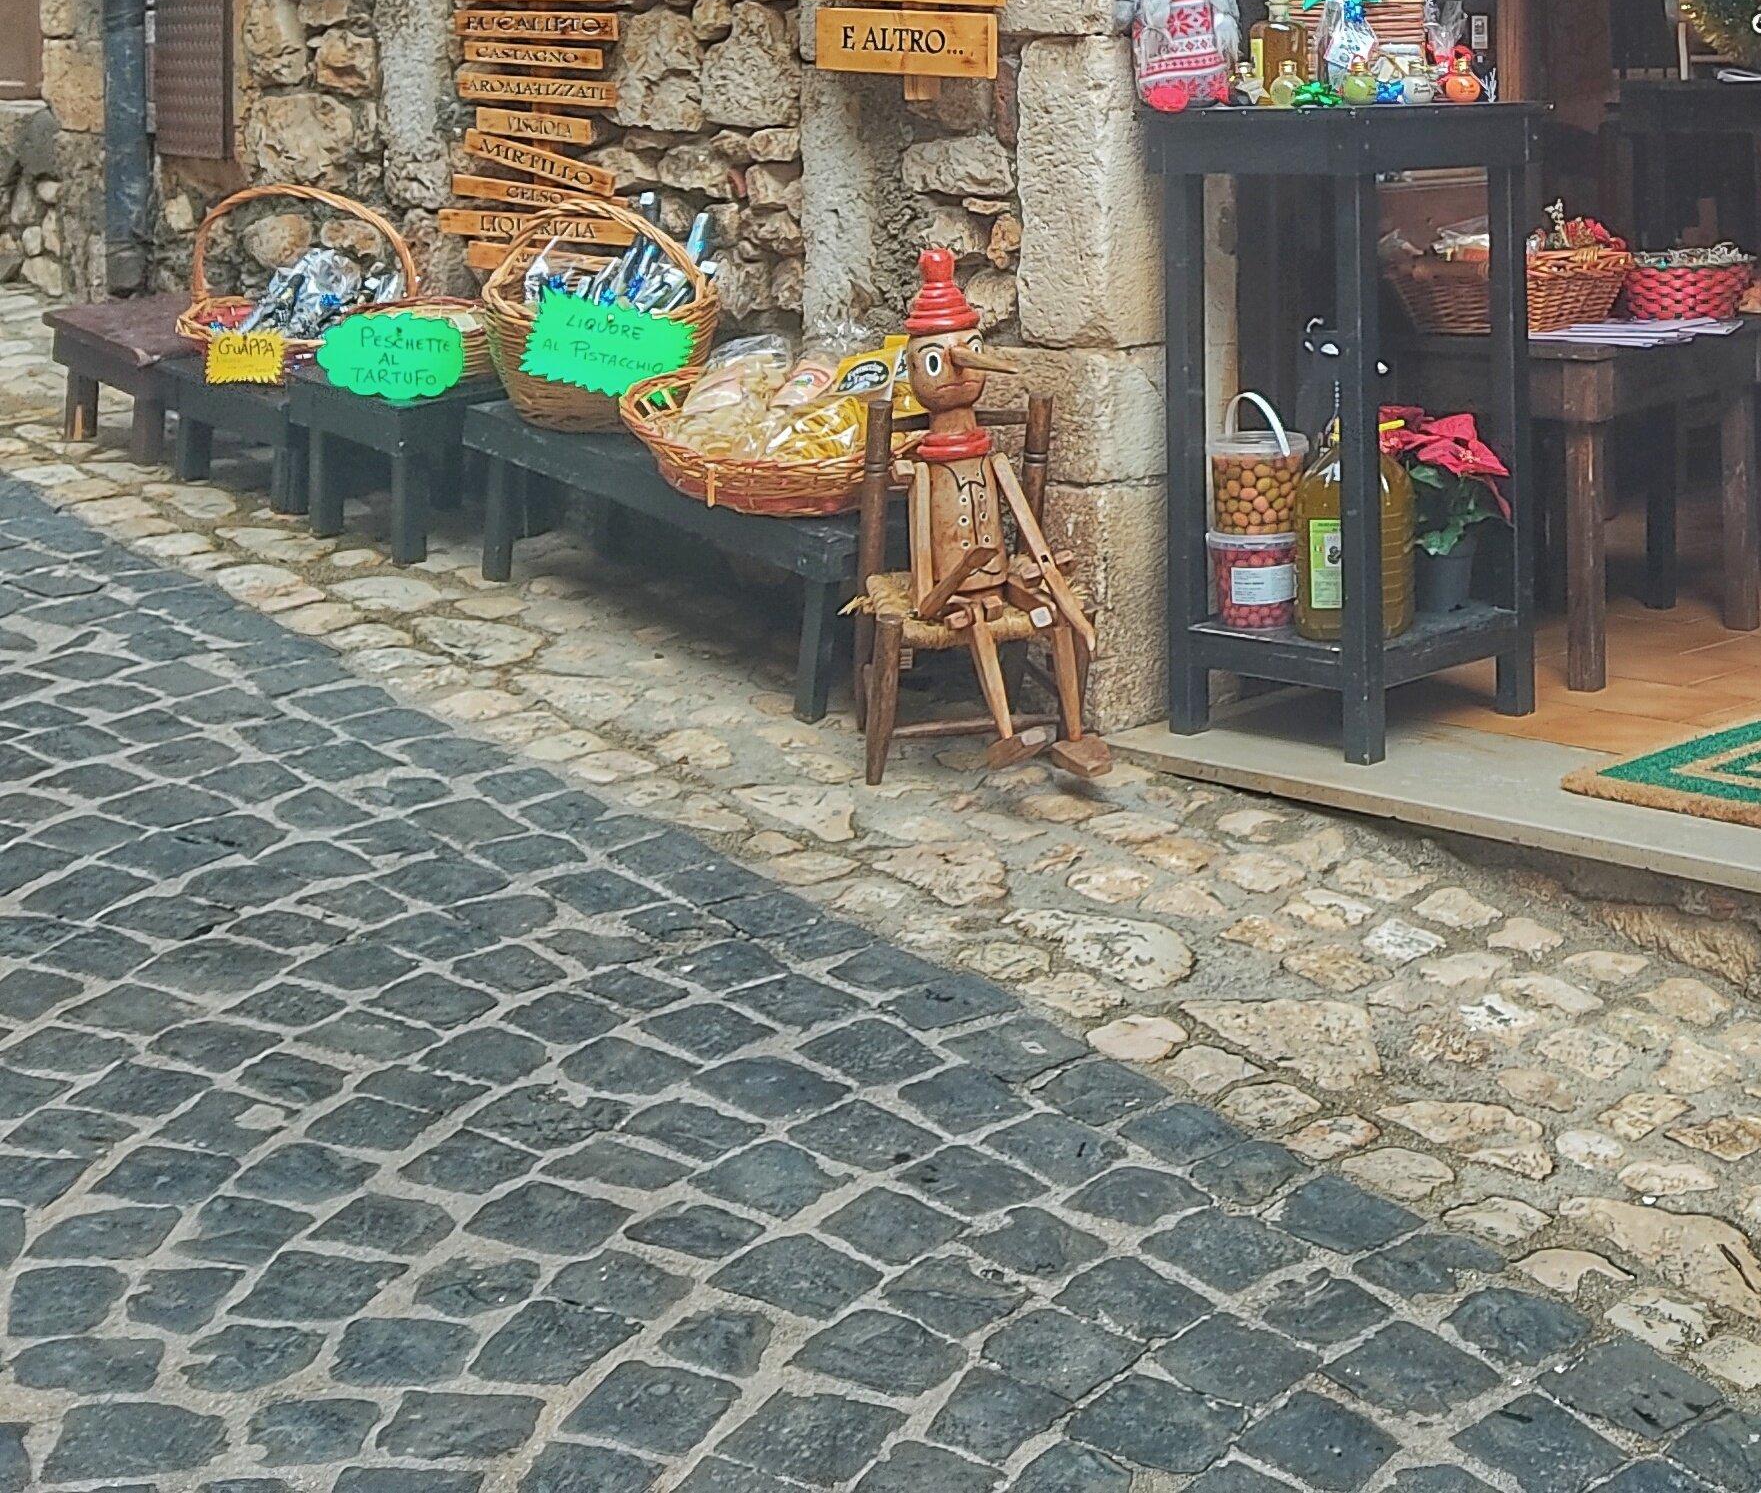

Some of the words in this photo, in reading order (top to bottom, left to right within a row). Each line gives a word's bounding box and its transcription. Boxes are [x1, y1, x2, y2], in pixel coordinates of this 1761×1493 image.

[466, 15, 601, 34] EUCALIPTO
[841, 26, 855, 50] E
[861, 28, 964, 56] ALTRO...
[475, 46, 579, 64] CASTAGNO
[467, 79, 607, 100] AROMATIZZATI
[507, 116, 572, 139] VISCIOLA
[480, 138, 593, 186] MIRTILLO
[506, 186, 565, 204] GELSO
[480, 215, 597, 241] LIQRIZIA
[565, 313, 645, 340] LIQUORE
[361, 326, 451, 352] PESCHETTE
[379, 352, 399, 365] AL
[542, 338, 559, 351] AL
[572, 342, 664, 373] PISTACCHIO
[351, 367, 437, 386] TARTUFO
